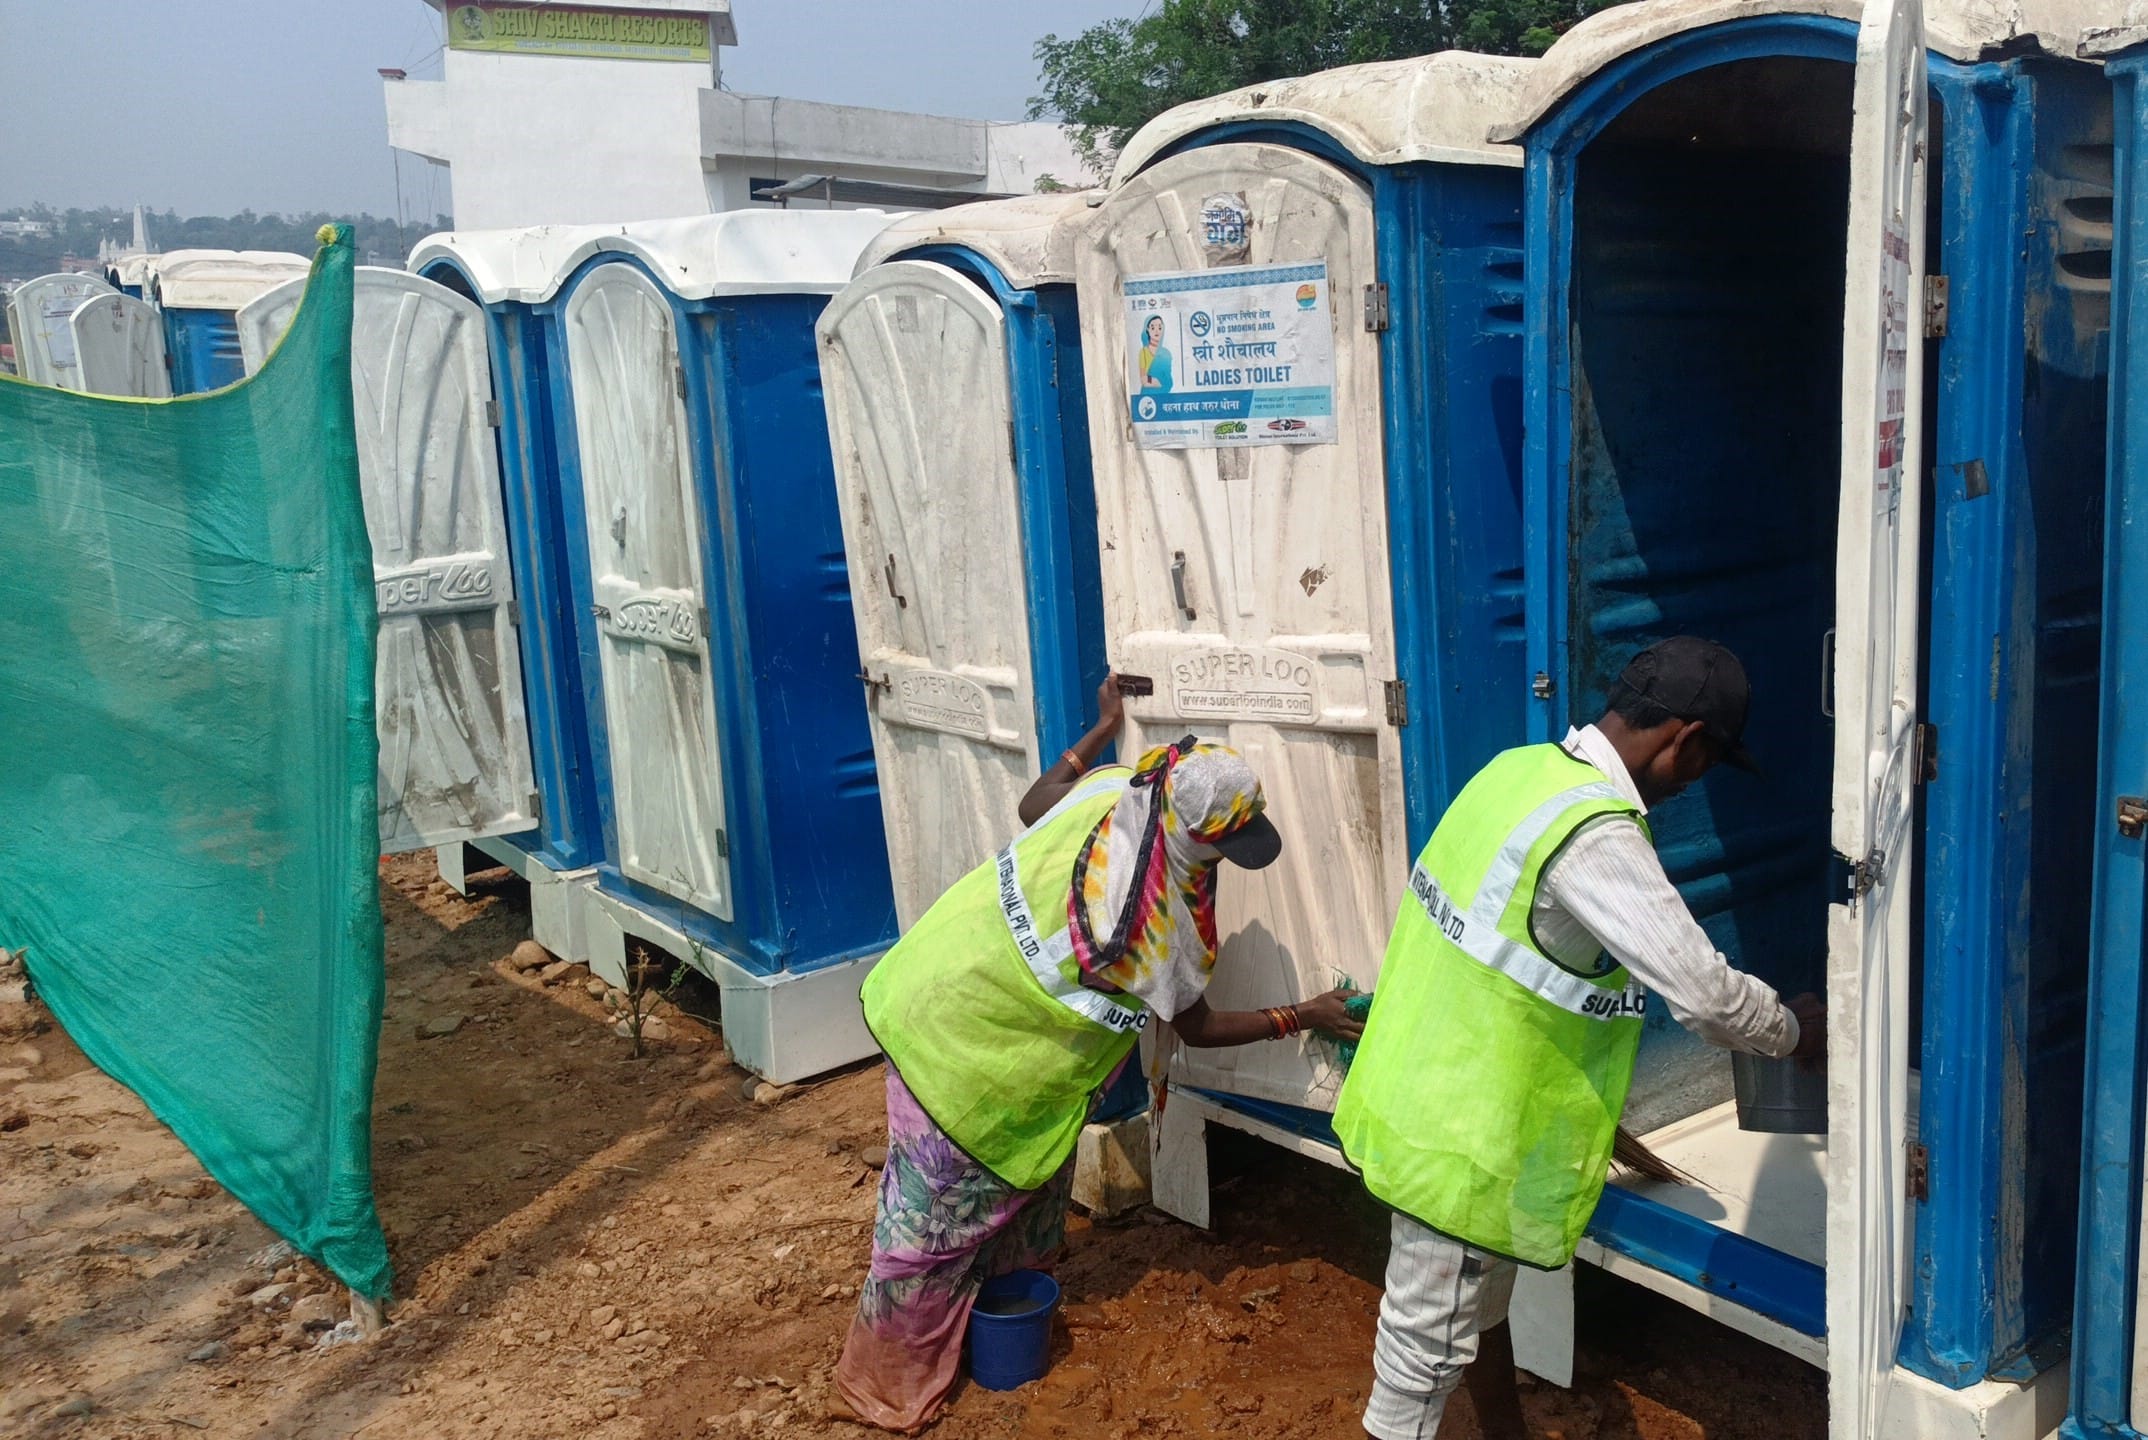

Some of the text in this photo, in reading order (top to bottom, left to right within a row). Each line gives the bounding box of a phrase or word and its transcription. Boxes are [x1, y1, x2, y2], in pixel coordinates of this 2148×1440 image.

[494, 8, 705, 47] SHIV SHAKTI RESORTS
[1217, 322, 1275, 334] NO SMOKING AREA
[1192, 337, 1276, 363] स्त्री शौचालय
[1195, 365, 1292, 387] LADIES TOILET
[376, 568, 442, 613] per
[1175, 653, 1312, 688] SUPER LOO
[901, 675, 982, 713] SUPER LOO
[1019, 935, 1041, 961] LTD.
